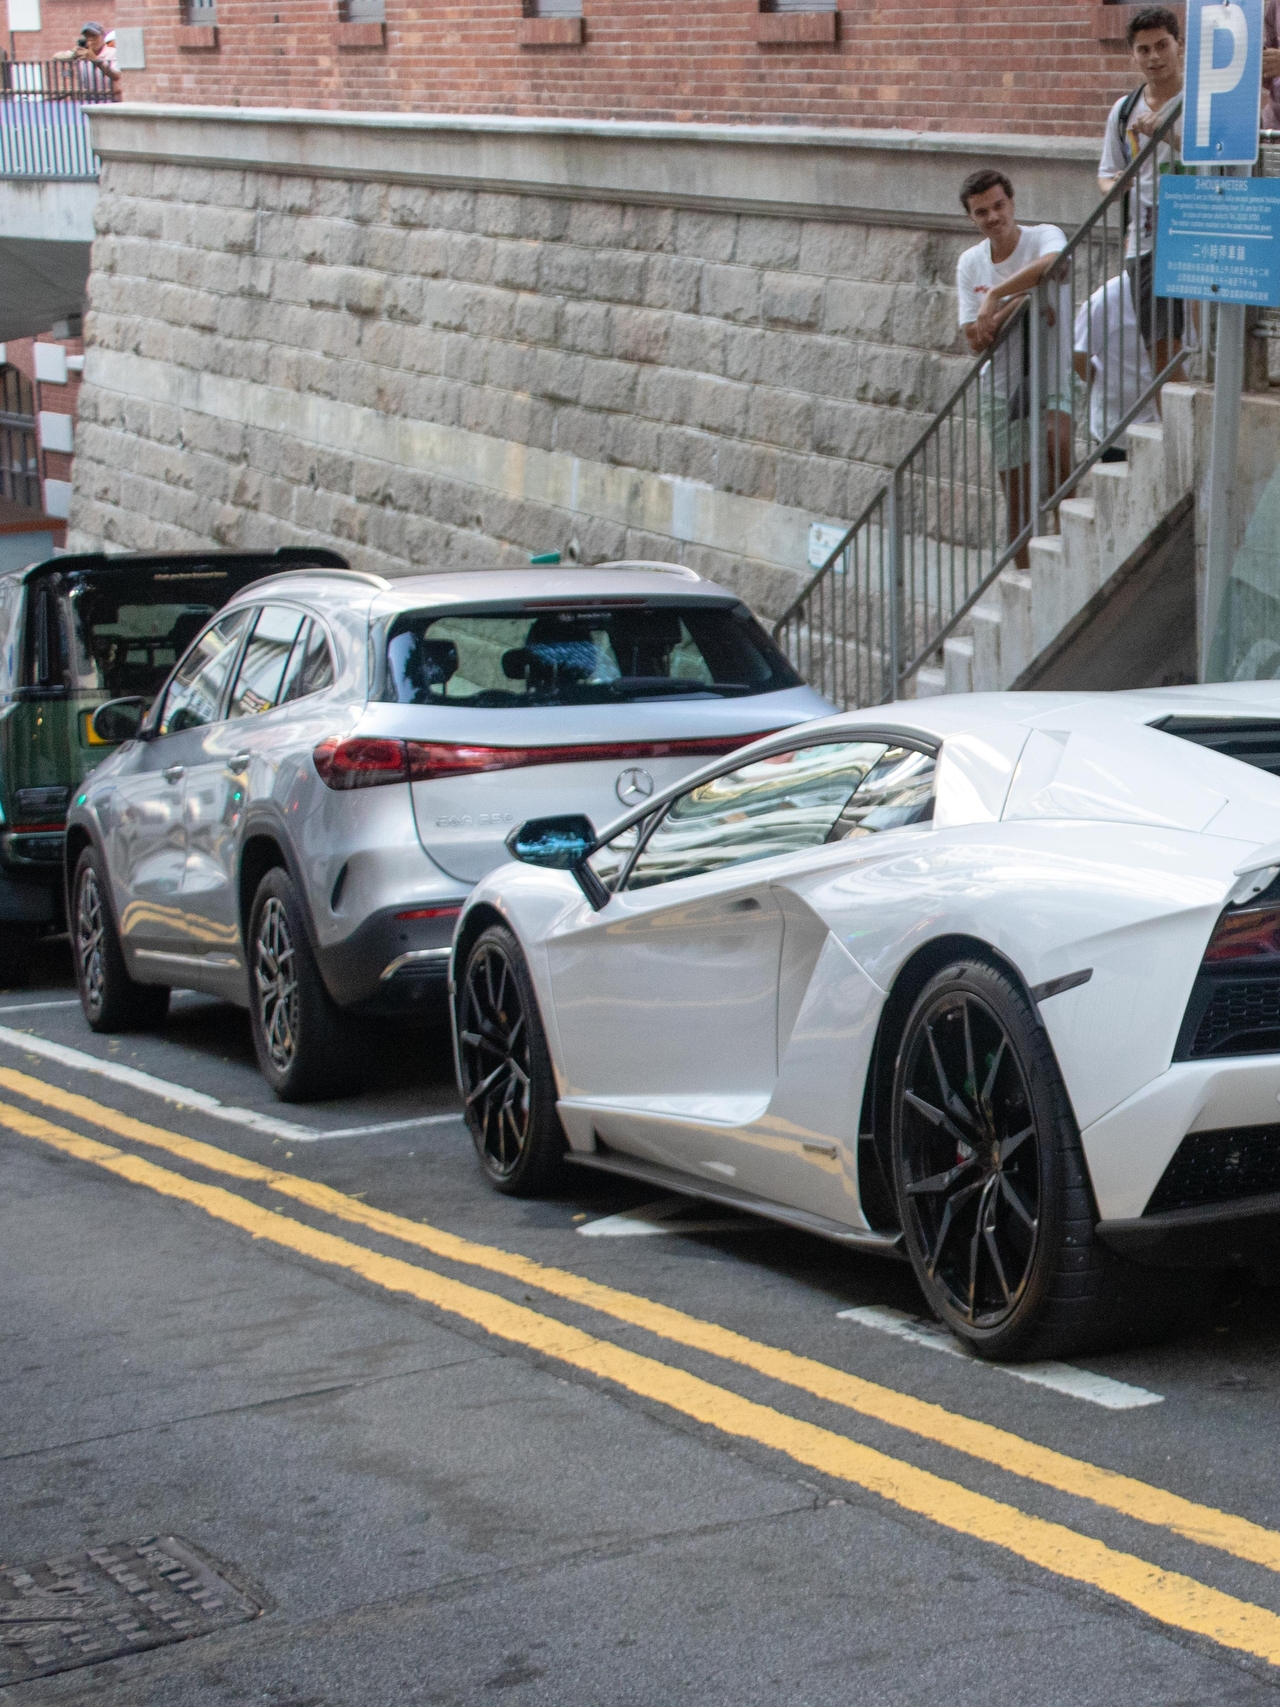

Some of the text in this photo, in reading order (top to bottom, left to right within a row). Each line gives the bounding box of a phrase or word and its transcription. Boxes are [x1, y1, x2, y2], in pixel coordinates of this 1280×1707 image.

[1195, 3, 1249, 147] P
[1222, 180, 1248, 191] METERS
[479, 812, 515, 826] 250
